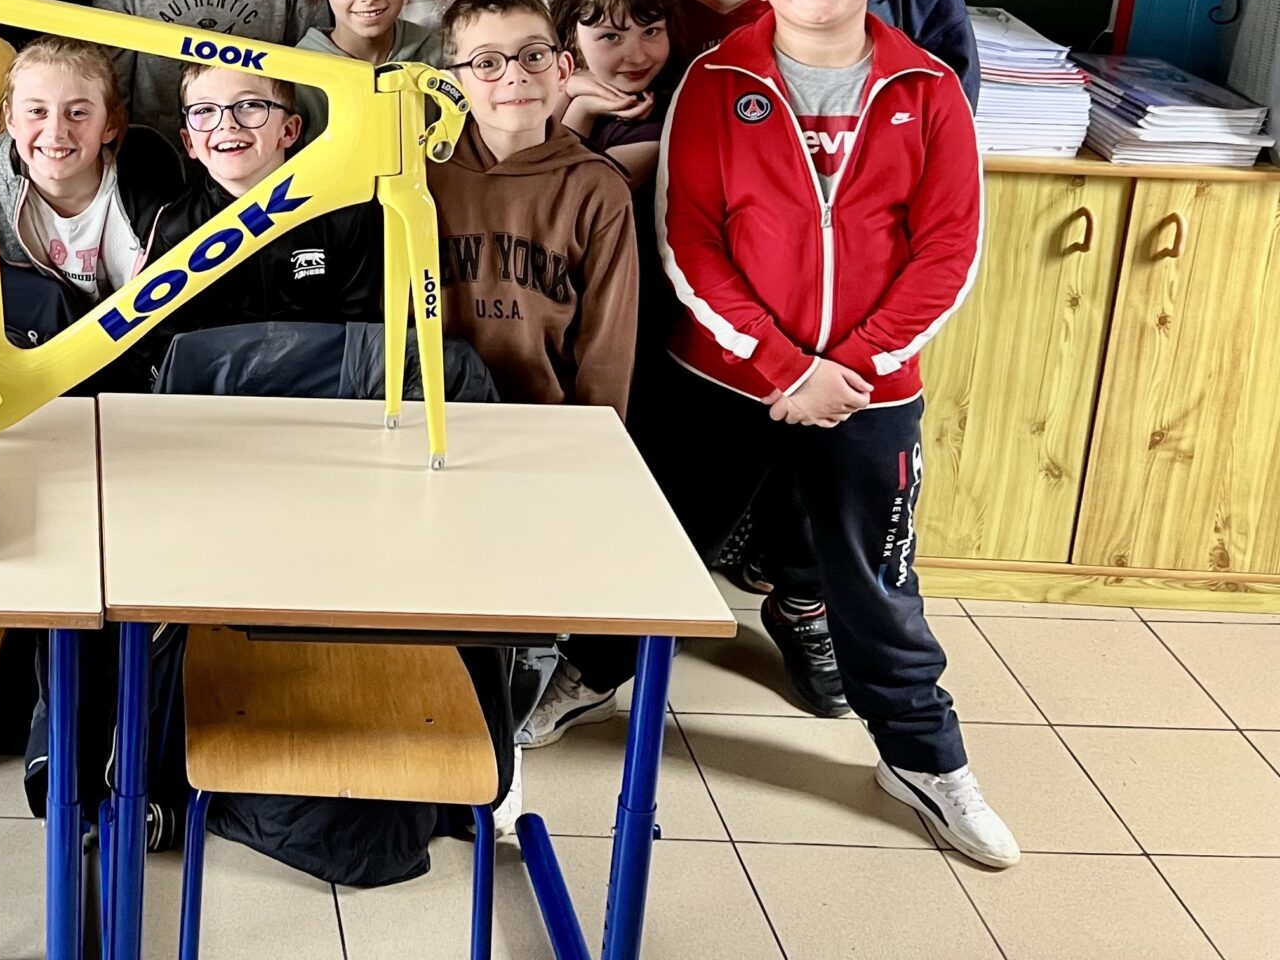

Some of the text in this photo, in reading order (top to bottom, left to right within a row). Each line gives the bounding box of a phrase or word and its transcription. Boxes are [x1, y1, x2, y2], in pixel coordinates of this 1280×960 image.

[180, 37, 268, 71] LOOK
[441, 82, 462, 100] LOOK
[97, 173, 315, 342] LOOK
[492, 231, 572, 306] YORK
[423, 269, 438, 320] LOOK
[475, 299, 524, 321] U.S.A.
[883, 497, 903, 557] NEW YORK
